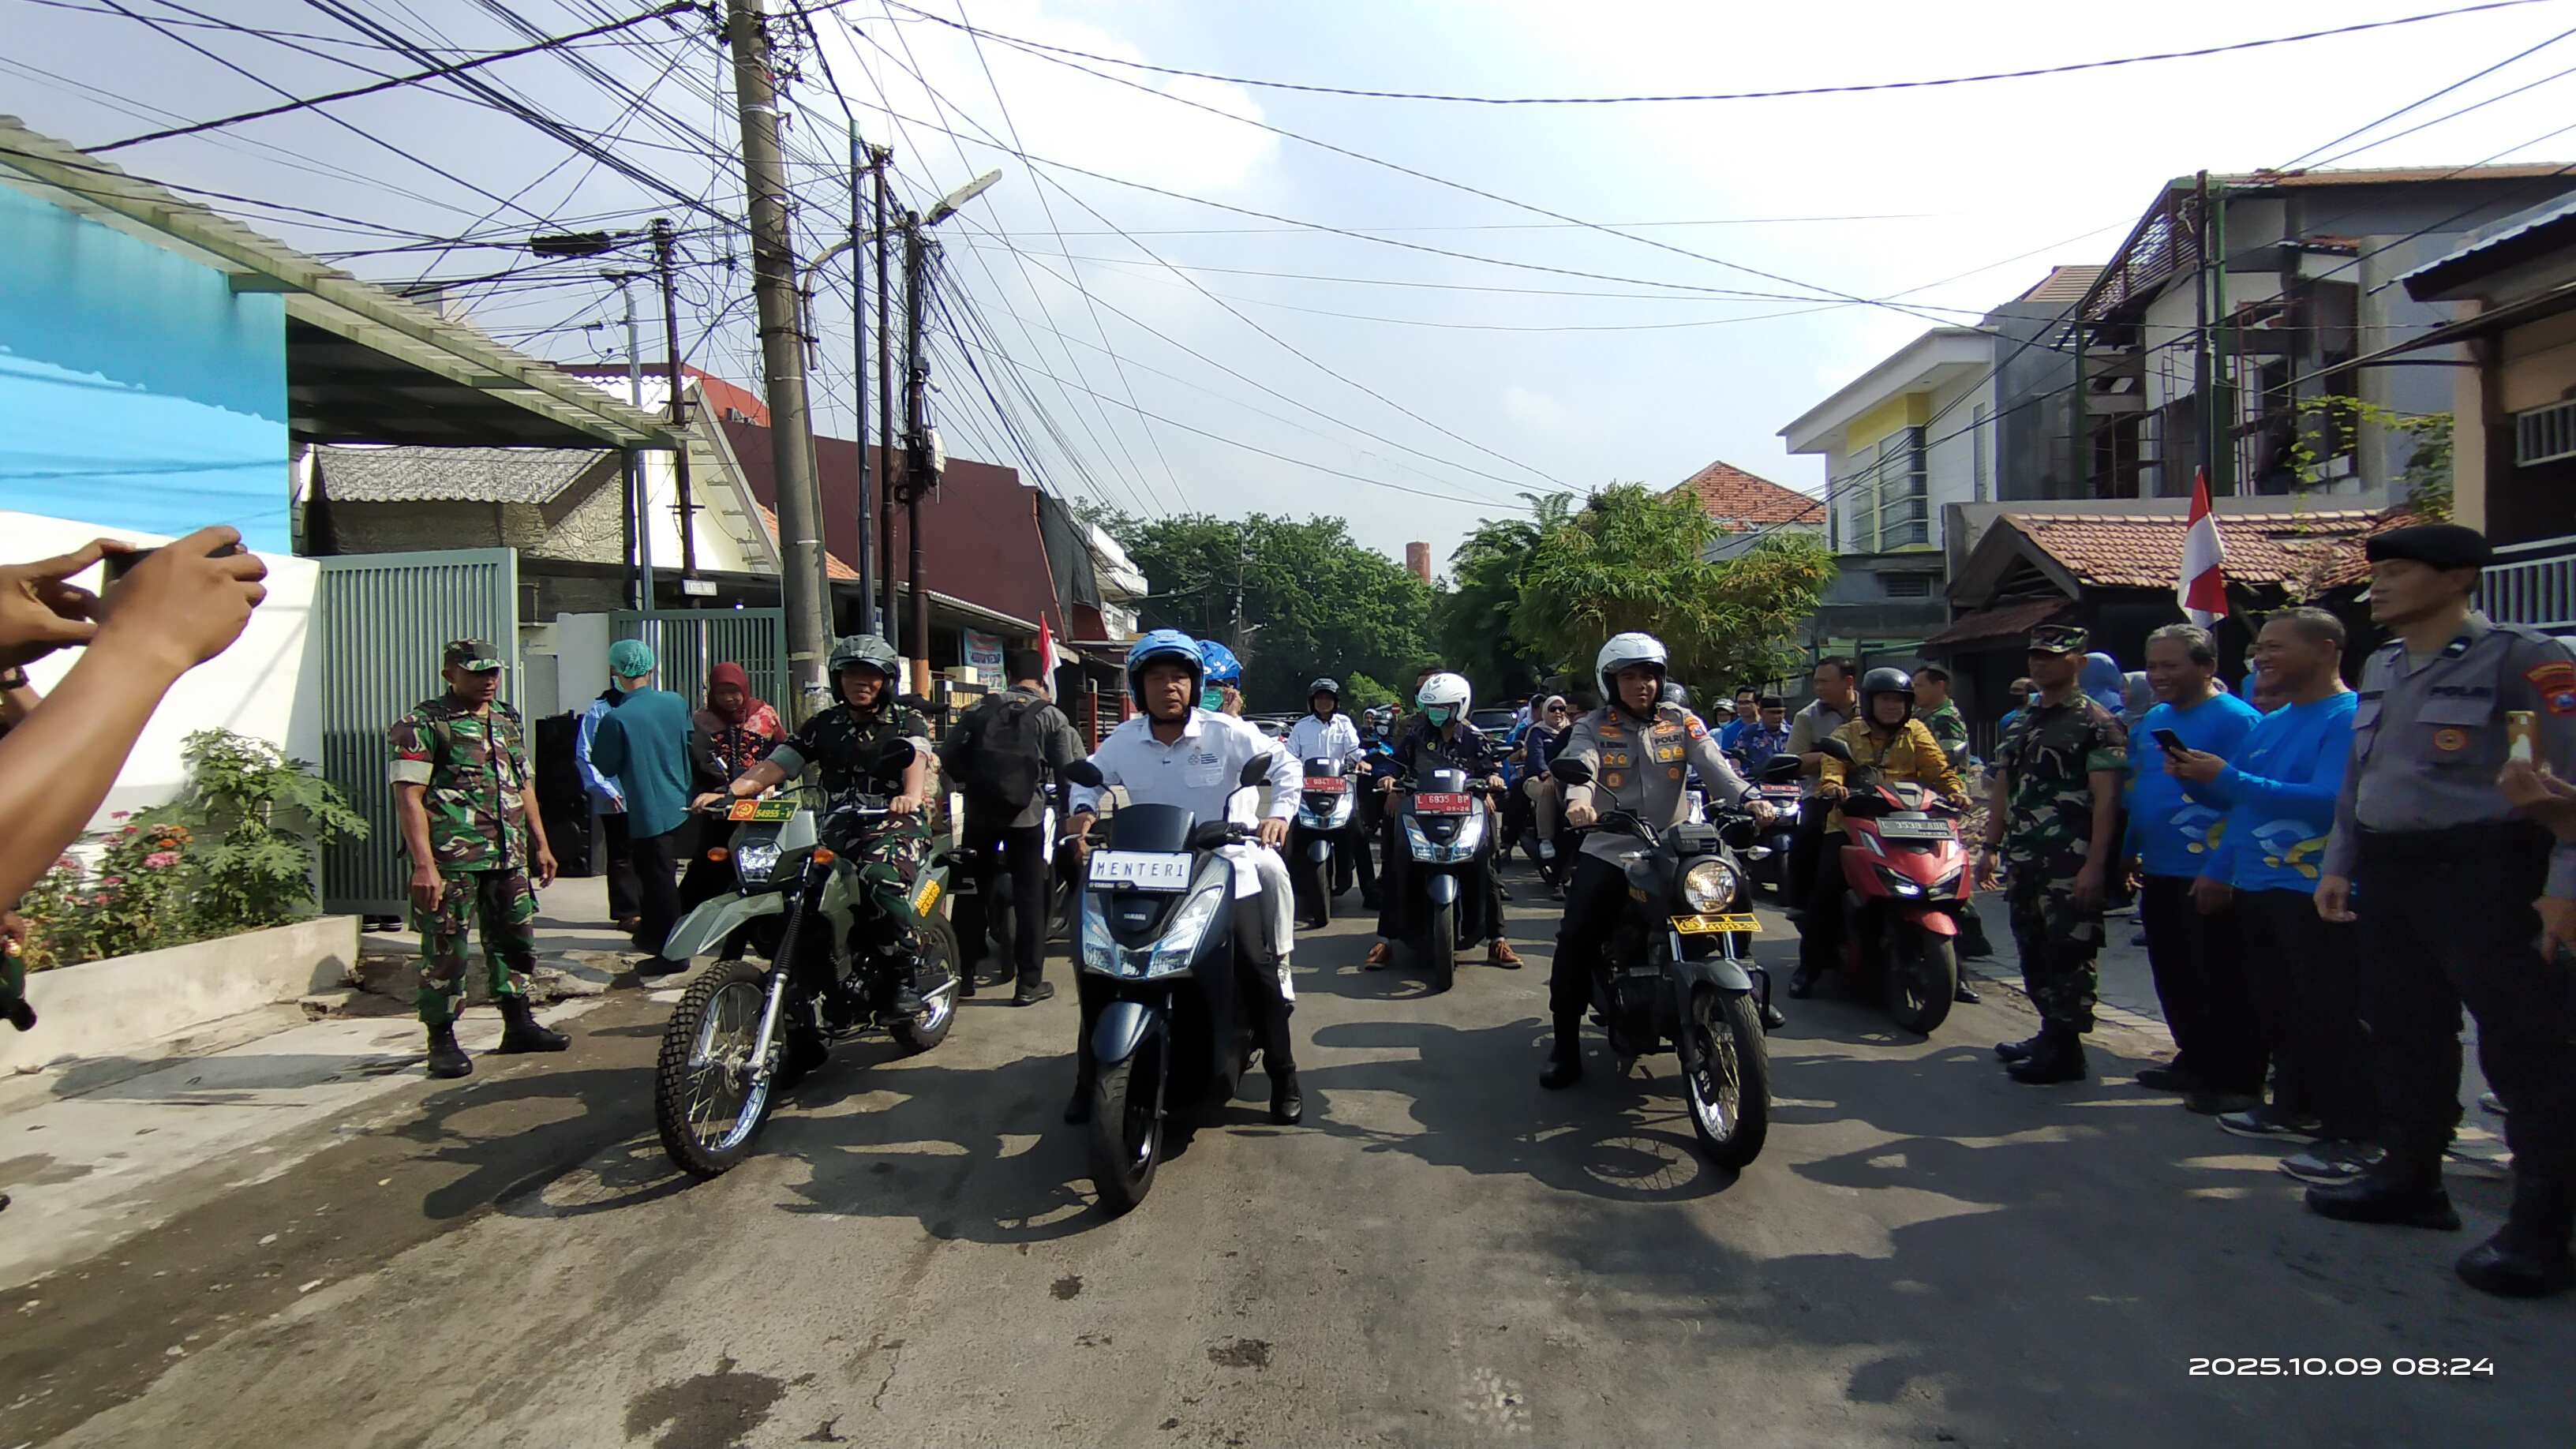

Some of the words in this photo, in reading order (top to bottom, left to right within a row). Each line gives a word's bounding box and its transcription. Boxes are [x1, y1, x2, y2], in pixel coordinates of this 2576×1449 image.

[1655, 734, 1682, 744] POLRI
[1417, 795, 1422, 804] L
[1457, 795, 1470, 803] BP
